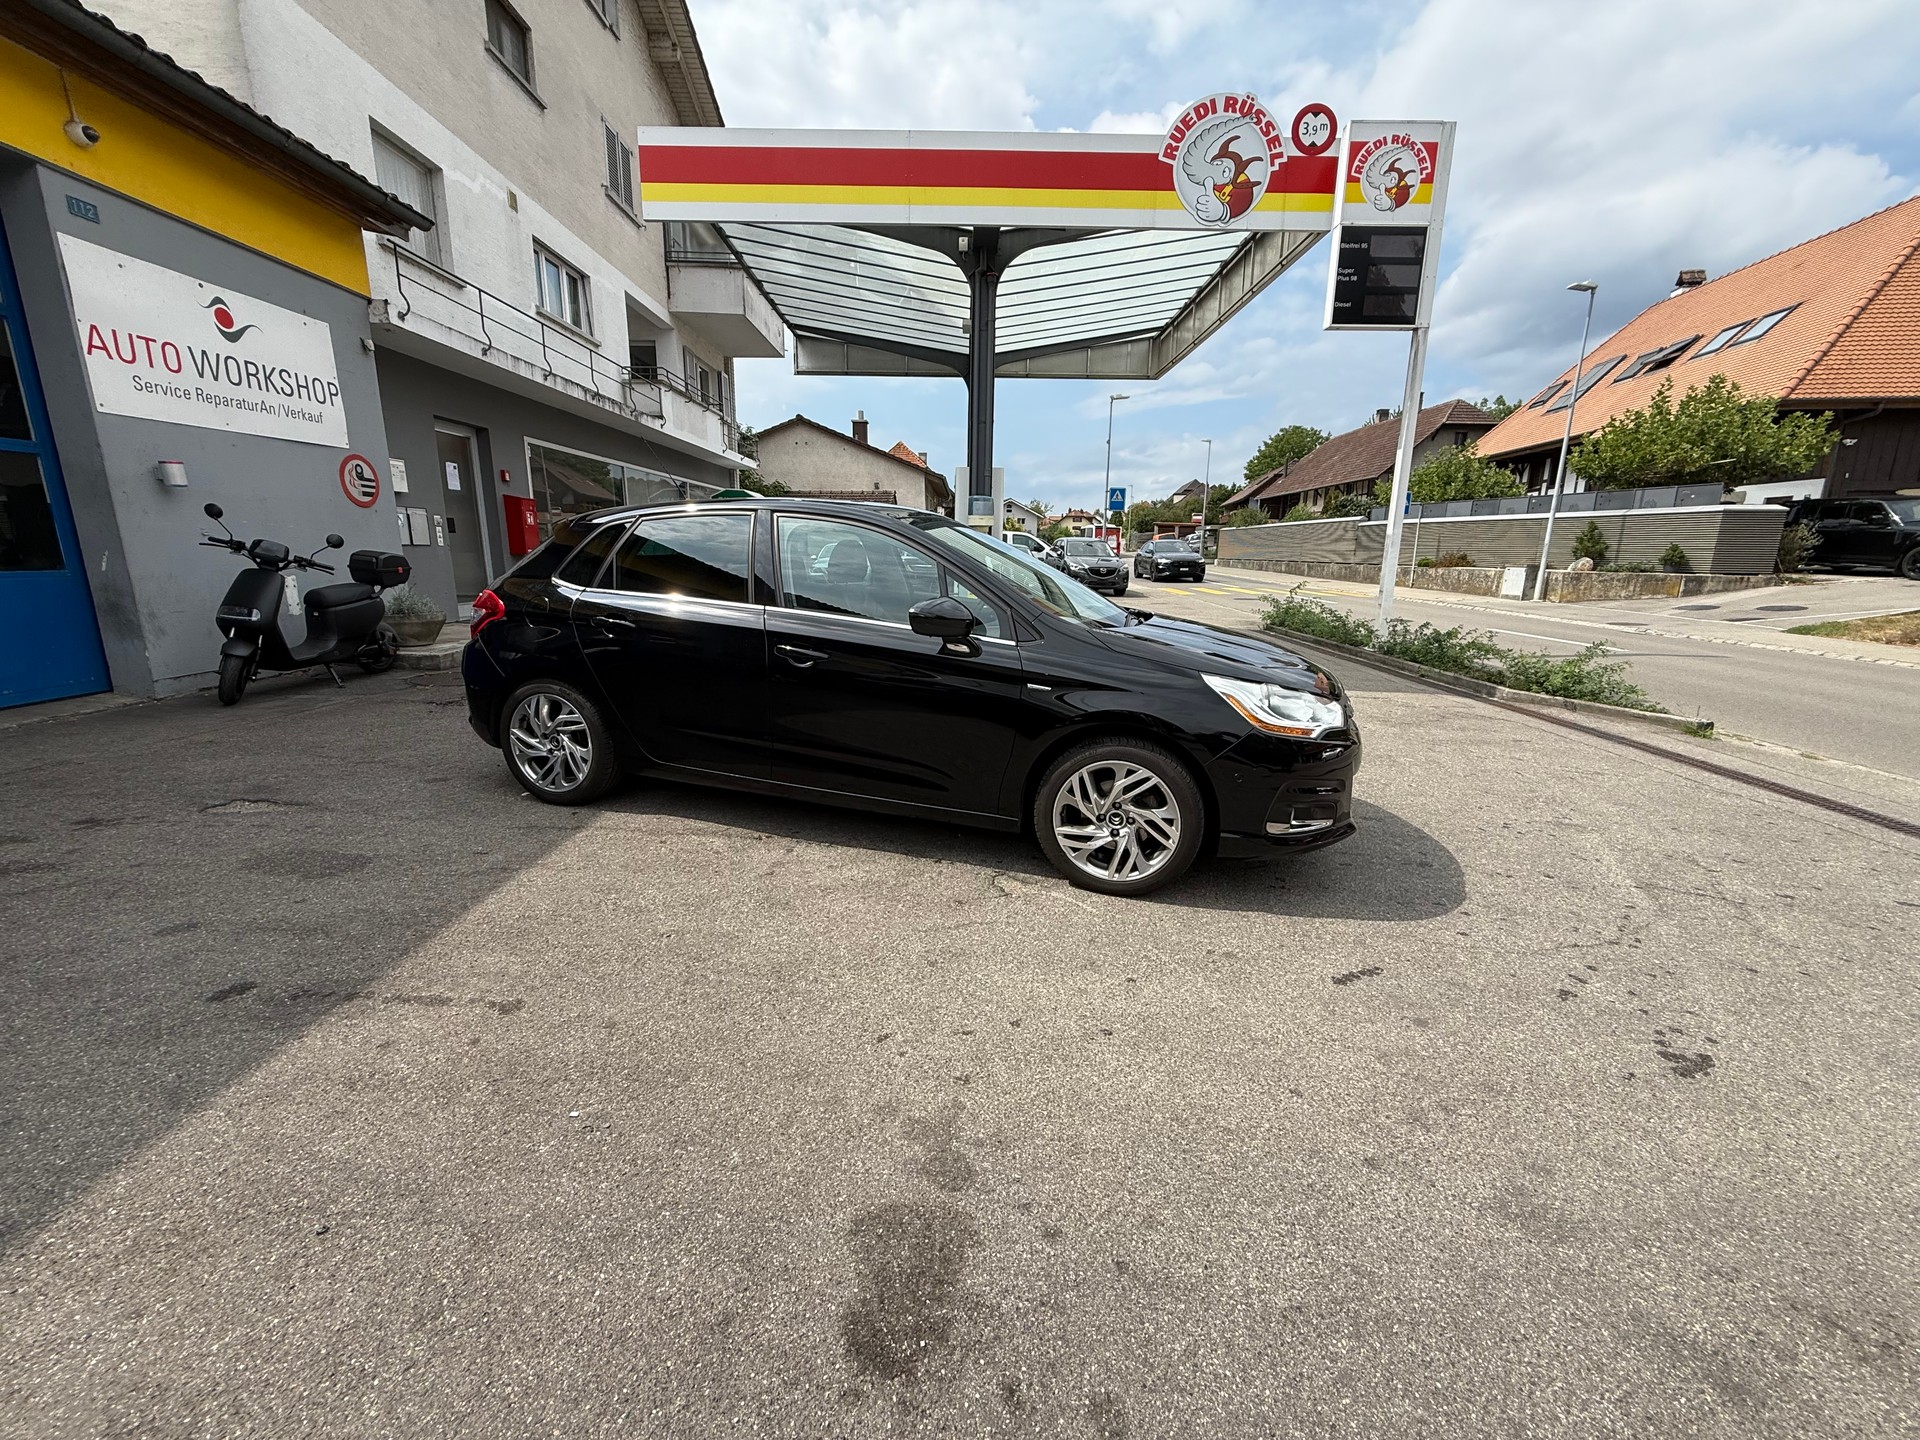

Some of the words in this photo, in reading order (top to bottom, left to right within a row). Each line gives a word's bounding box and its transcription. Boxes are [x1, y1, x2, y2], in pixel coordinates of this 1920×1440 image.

[1162, 98, 1218, 161] RUEDI
[1223, 94, 1285, 167] RÜSSEL
[1353, 136, 1388, 176] RUEDI
[1391, 133, 1429, 176] RÜSSEL
[72, 200, 97, 219] 112
[87, 323, 183, 374] AUTO
[187, 345, 339, 407] WORKSHOP
[132, 374, 191, 401] Service
